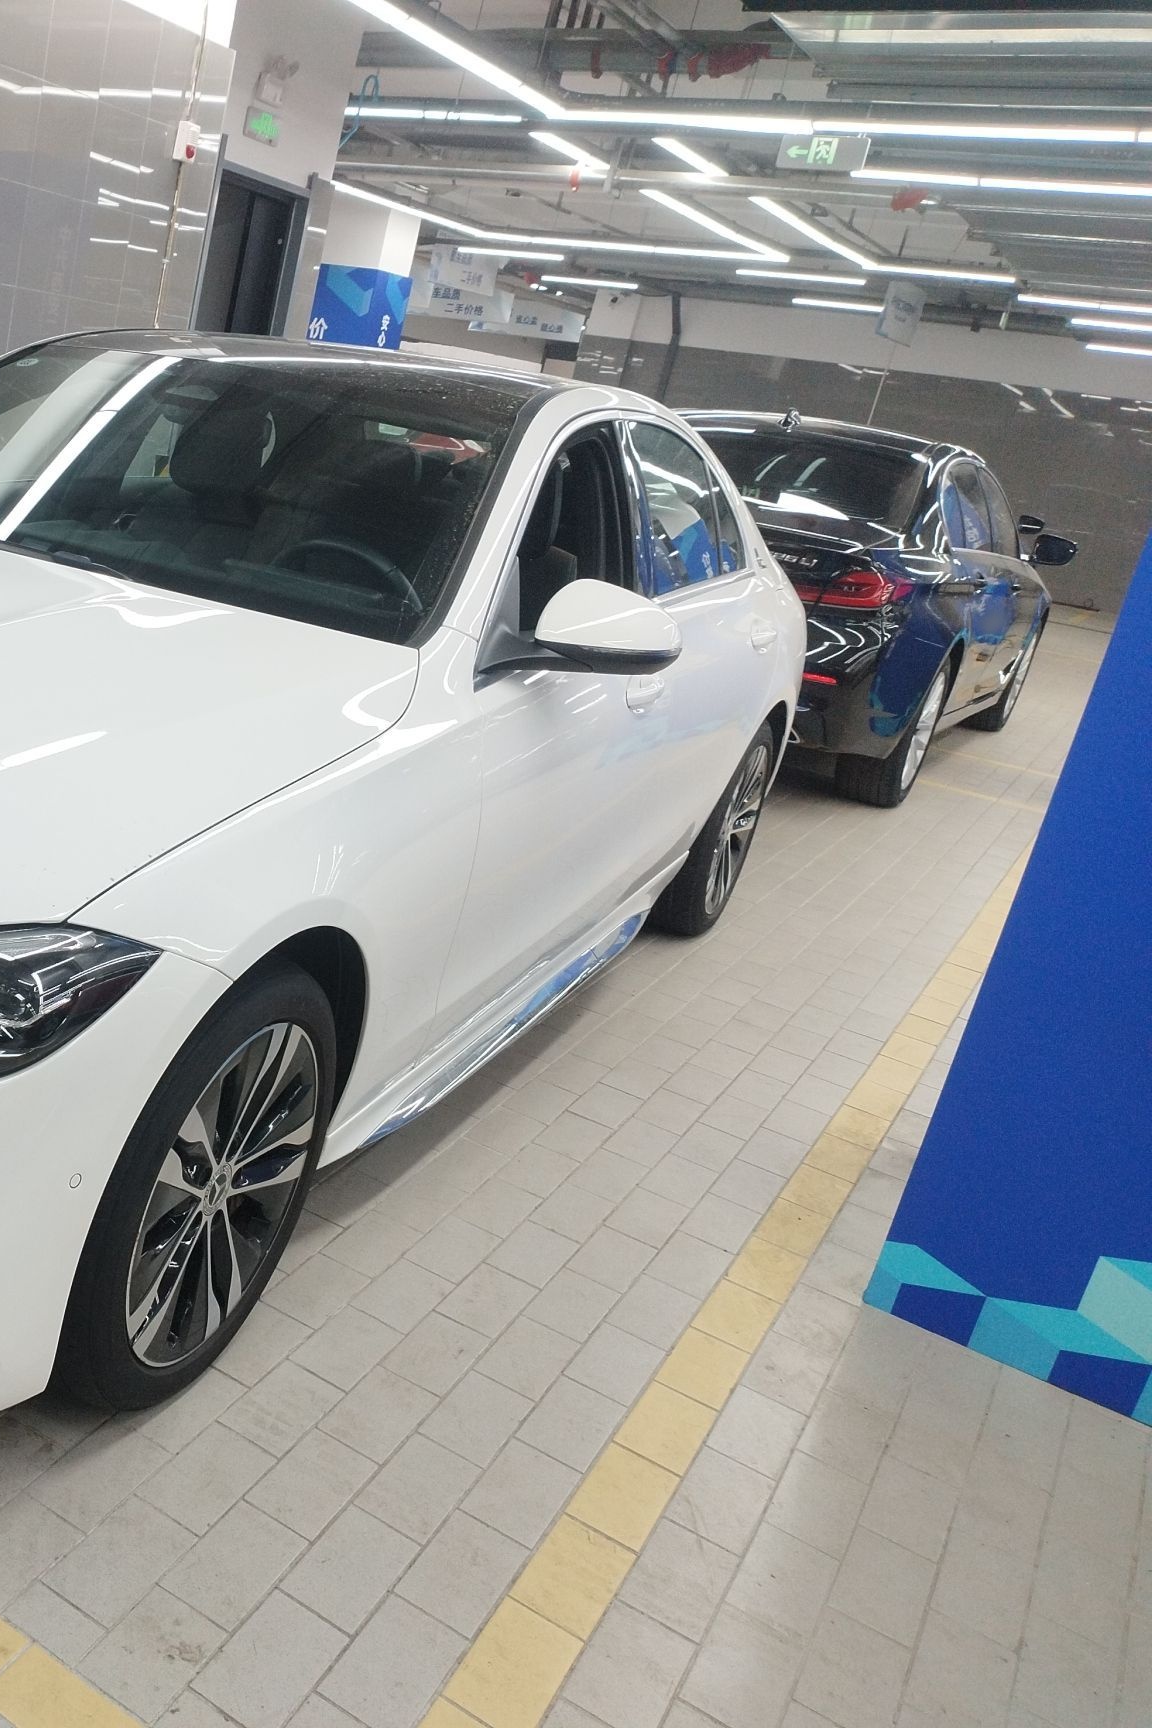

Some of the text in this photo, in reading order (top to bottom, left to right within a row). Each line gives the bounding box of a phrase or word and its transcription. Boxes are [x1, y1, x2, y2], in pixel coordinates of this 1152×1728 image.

[444, 302, 484, 317] 二手价格
[309, 317, 328, 340] 价
